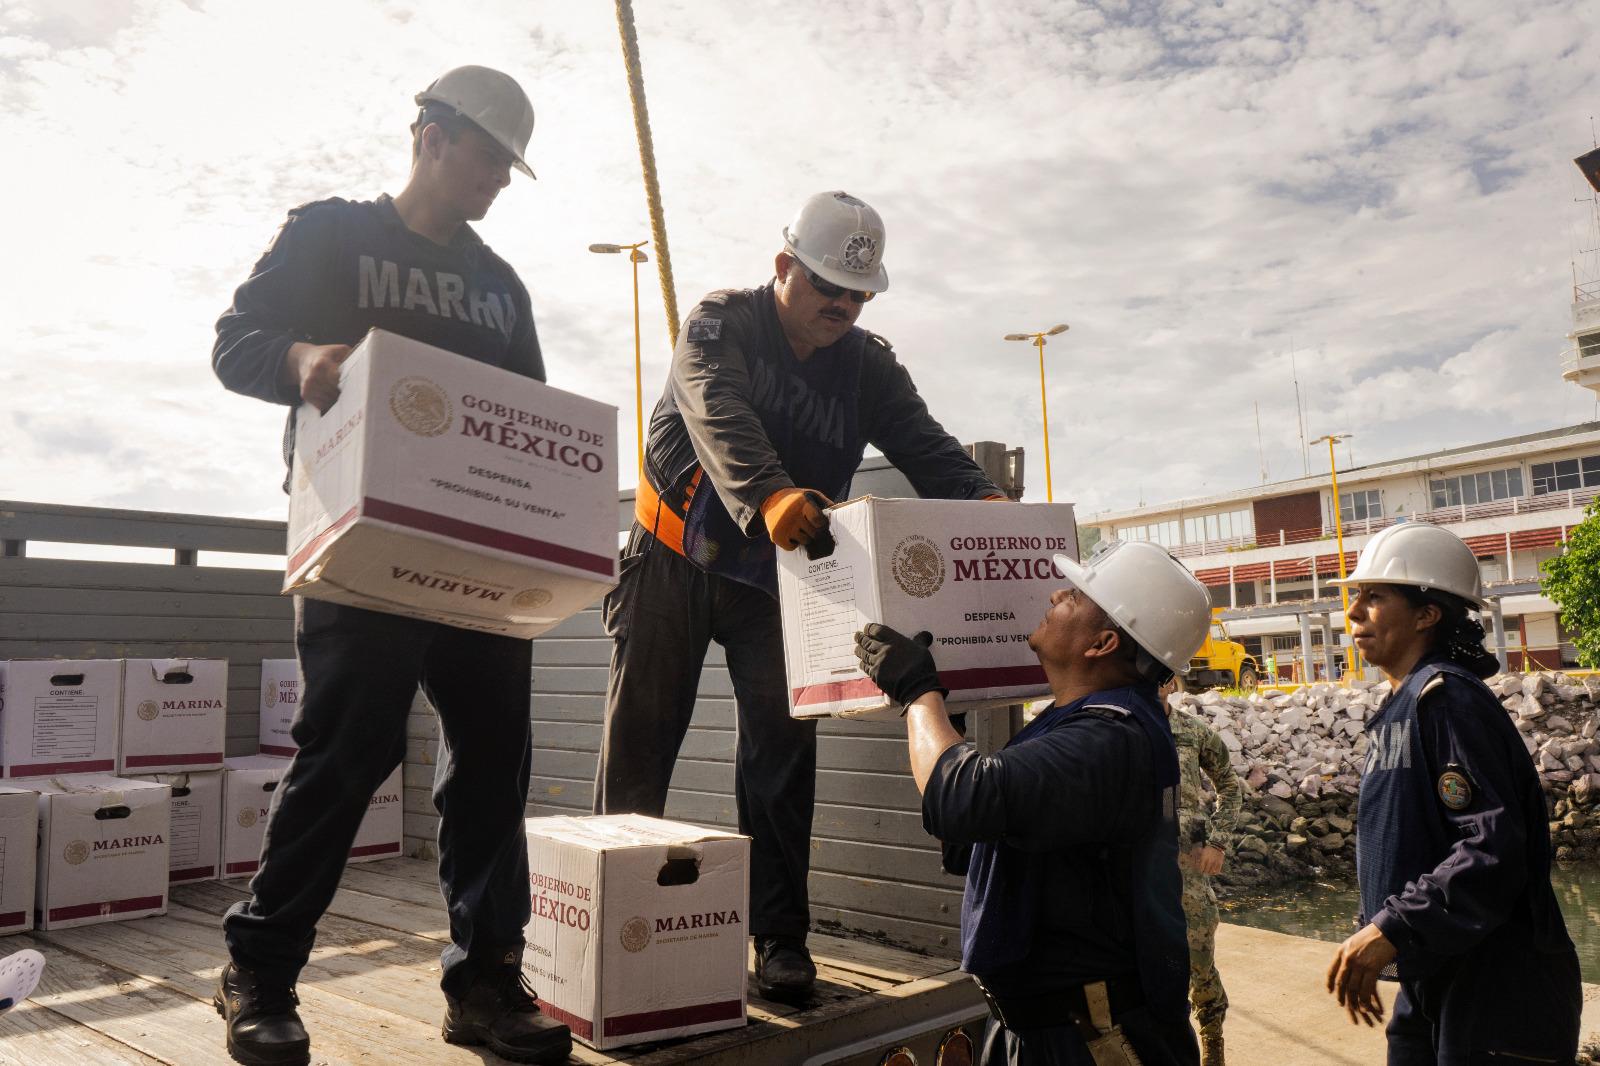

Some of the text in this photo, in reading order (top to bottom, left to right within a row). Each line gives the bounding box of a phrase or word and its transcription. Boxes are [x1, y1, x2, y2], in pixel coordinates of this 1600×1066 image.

[357, 255, 516, 347] MARIN
[461, 394, 572, 437] GOBIERNO
[578, 429, 604, 447] DE
[461, 415, 604, 474] MÉXICO
[468, 465, 533, 490] DESPENSA
[505, 499, 520, 508] SU
[950, 537, 1067, 551] GOBIERNO DE
[391, 566, 506, 601] MARINA
[964, 612, 1016, 622] DESPENSA
[936, 635, 994, 646] "PROHIBIDA
[996, 634, 1008, 642] SU
[162, 700, 223, 709] MARINA
[369, 794, 399, 805] RINA
[93, 834, 164, 851] MARINA
[577, 886, 591, 902] DE
[655, 910, 742, 933] MARINA
[526, 941, 552, 958] DESPENSA
